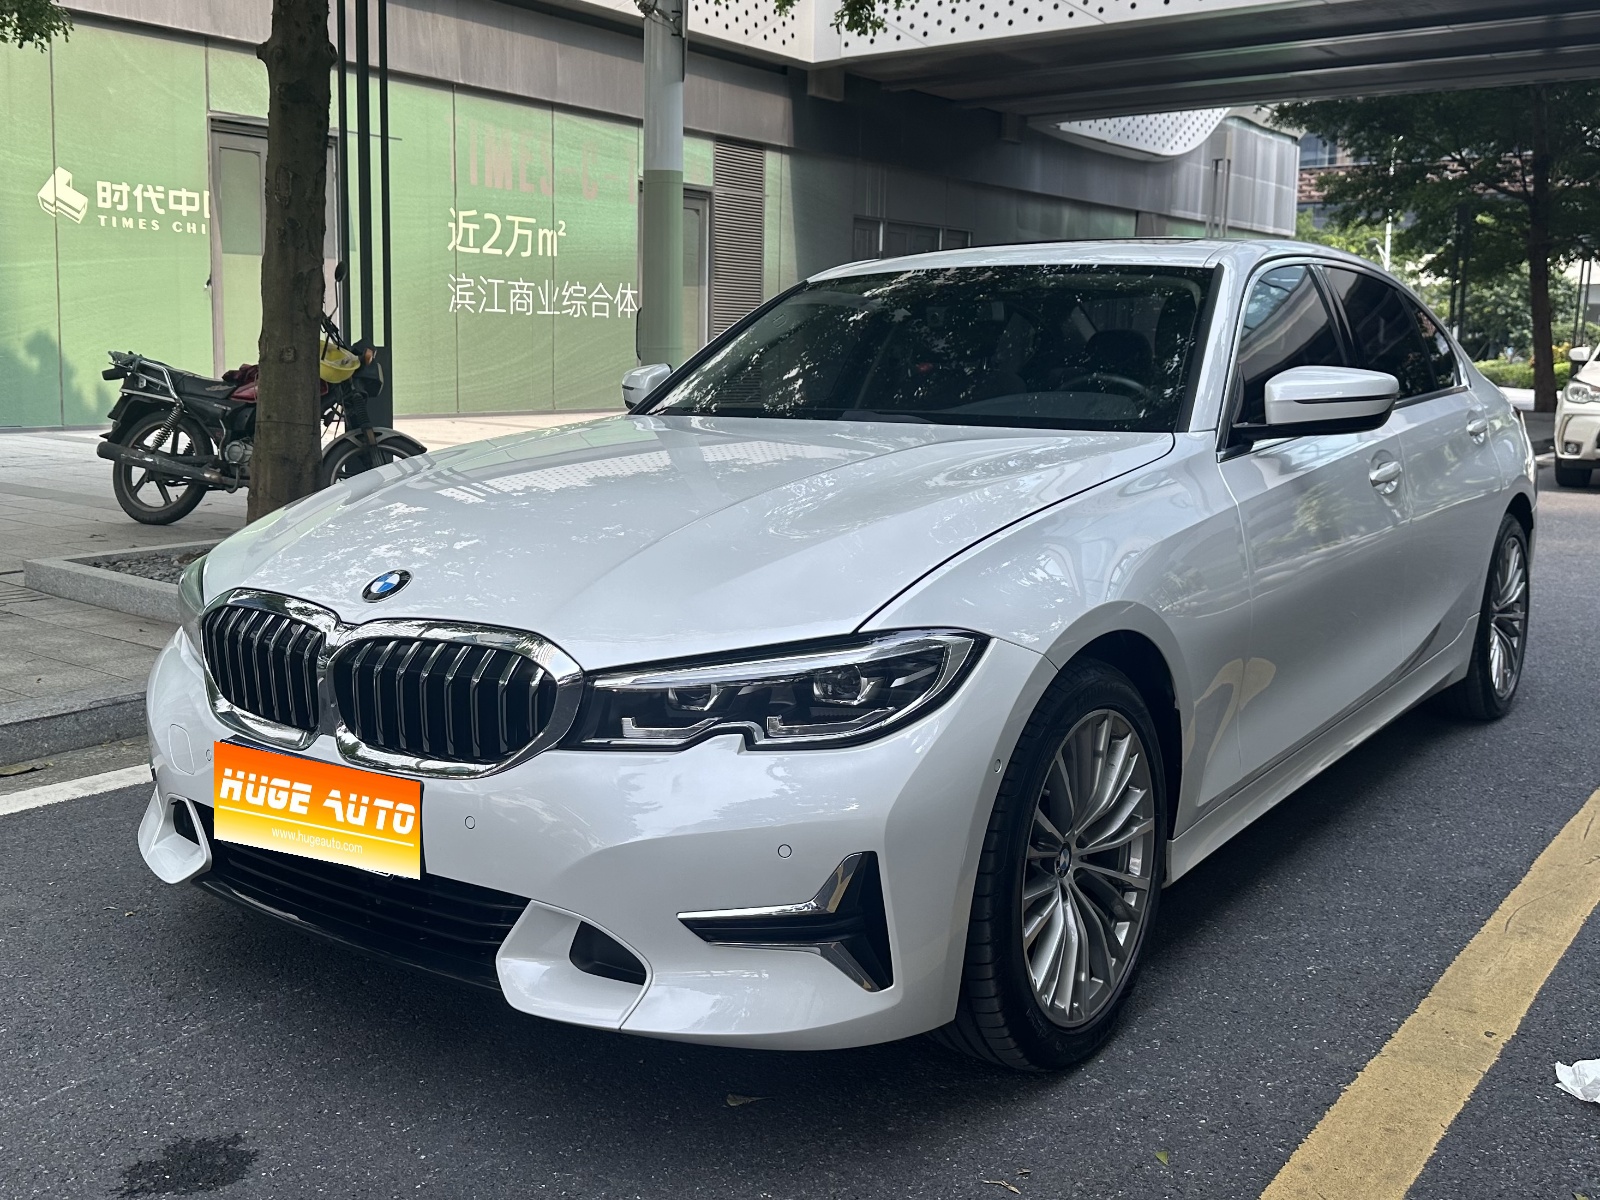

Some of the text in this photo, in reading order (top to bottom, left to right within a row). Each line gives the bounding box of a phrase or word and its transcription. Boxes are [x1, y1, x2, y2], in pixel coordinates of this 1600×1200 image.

[96, 180, 210, 219] 时代中
[97, 214, 160, 231] TIMES
[447, 272, 639, 319] 滨江商业综合体
